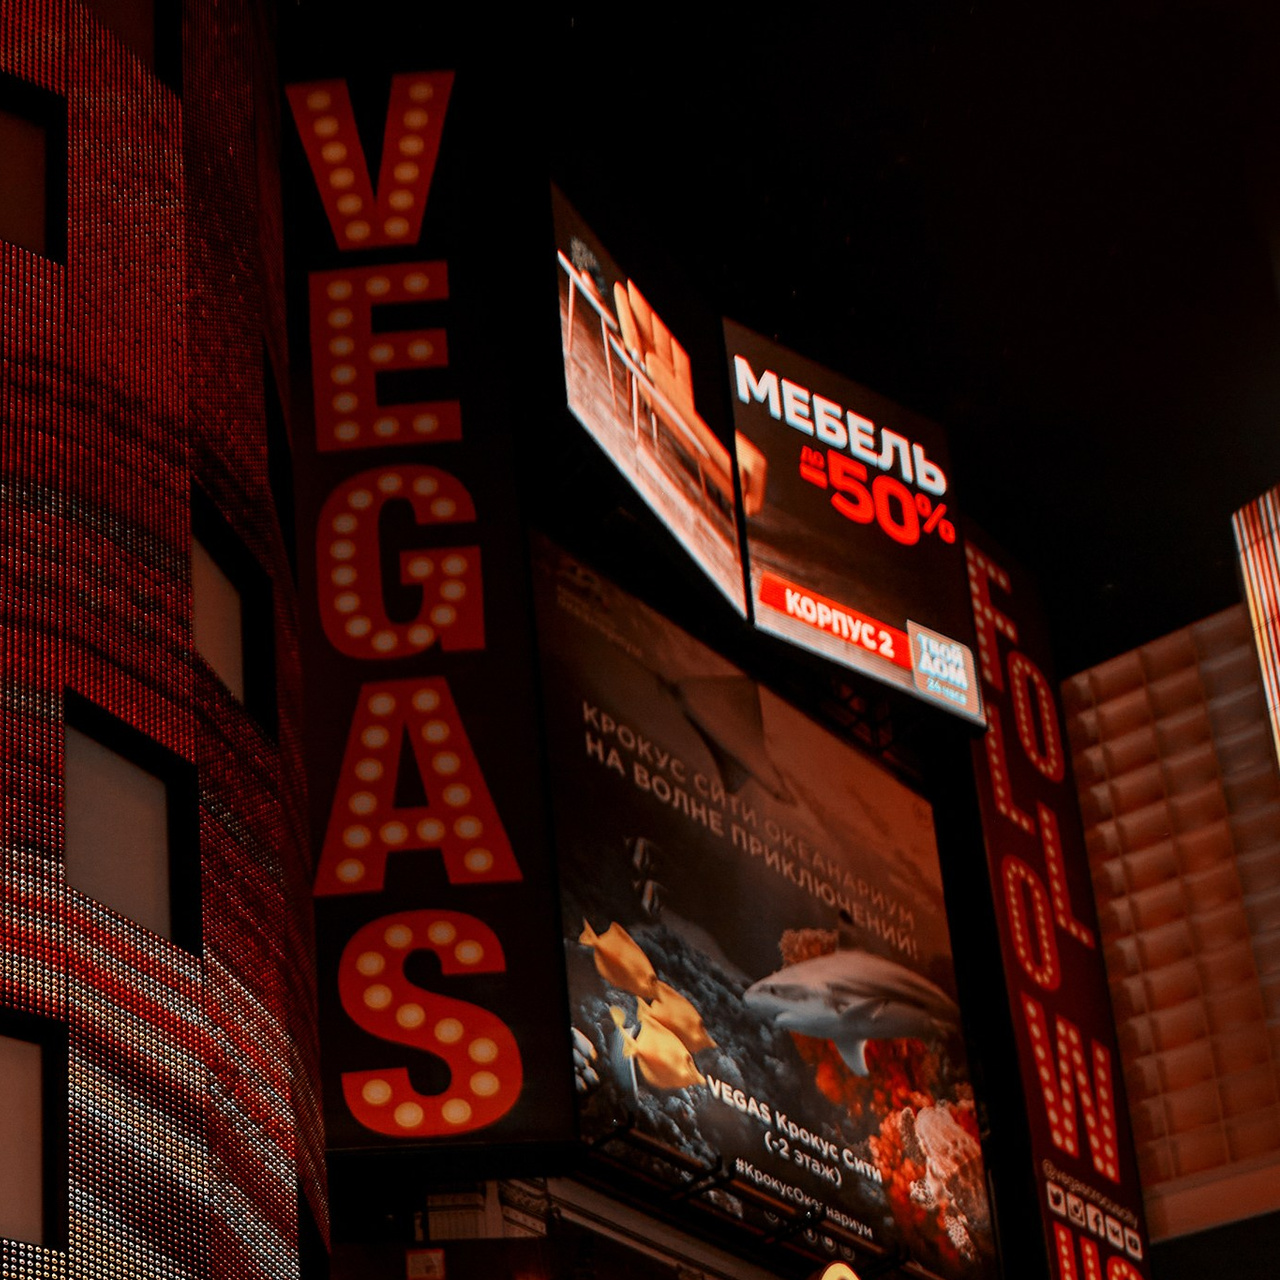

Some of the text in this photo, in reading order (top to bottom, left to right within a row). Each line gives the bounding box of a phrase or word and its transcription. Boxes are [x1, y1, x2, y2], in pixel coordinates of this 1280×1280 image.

[733, 353, 948, 496] МЕБЕЛЬ
[285, 70, 523, 1137] VEGAS
[785, 587, 896, 659] КОРПУС 2
[916, 632, 963, 669] ТВОЙ
[918, 655, 968, 691] ДОМ
[582, 700, 686, 778] КРОКУС
[584, 731, 627, 777] НА
[632, 758, 725, 837] ВОЛНЕ
[706, 1074, 883, 1186] VEGAS Крокус Сити
[793, 1148, 843, 1189] этаж)
